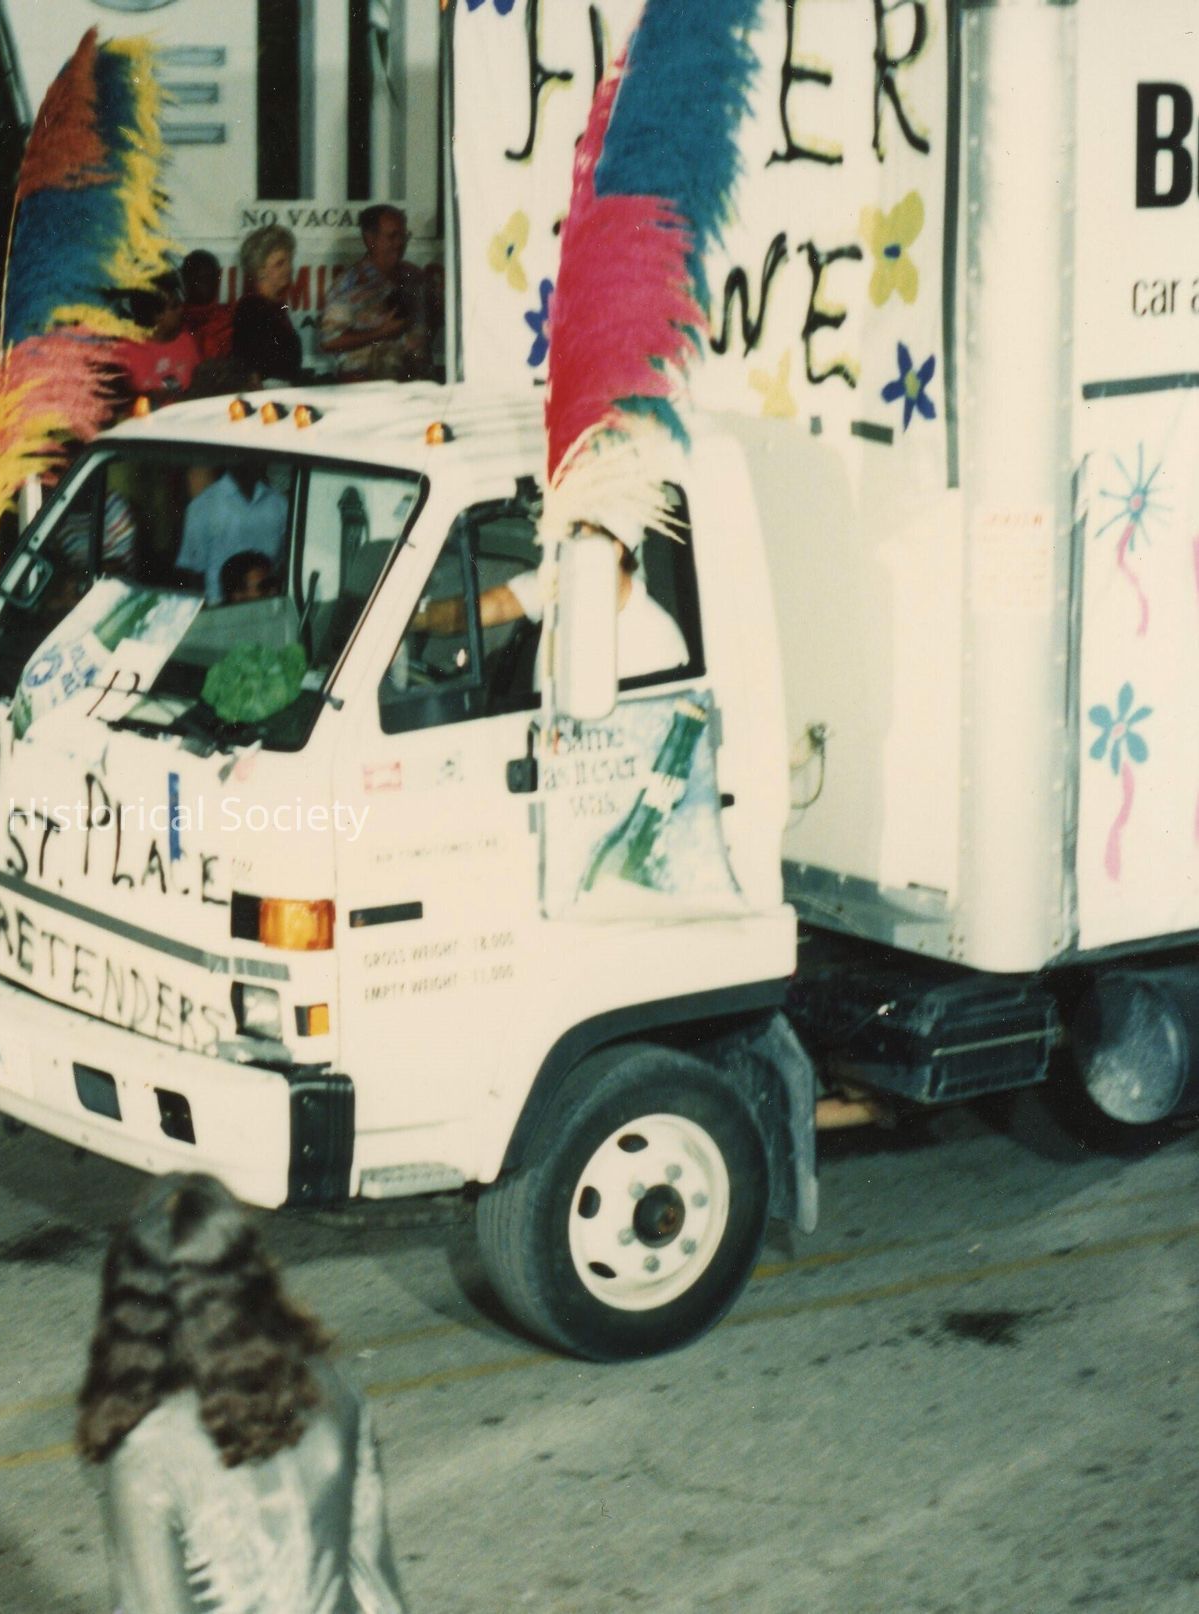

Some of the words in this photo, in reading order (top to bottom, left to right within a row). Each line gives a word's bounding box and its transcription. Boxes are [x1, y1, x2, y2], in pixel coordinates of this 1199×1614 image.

[1134, 81, 1199, 209] B
[242, 209, 279, 228] NO
[1131, 278, 1182, 318] car
